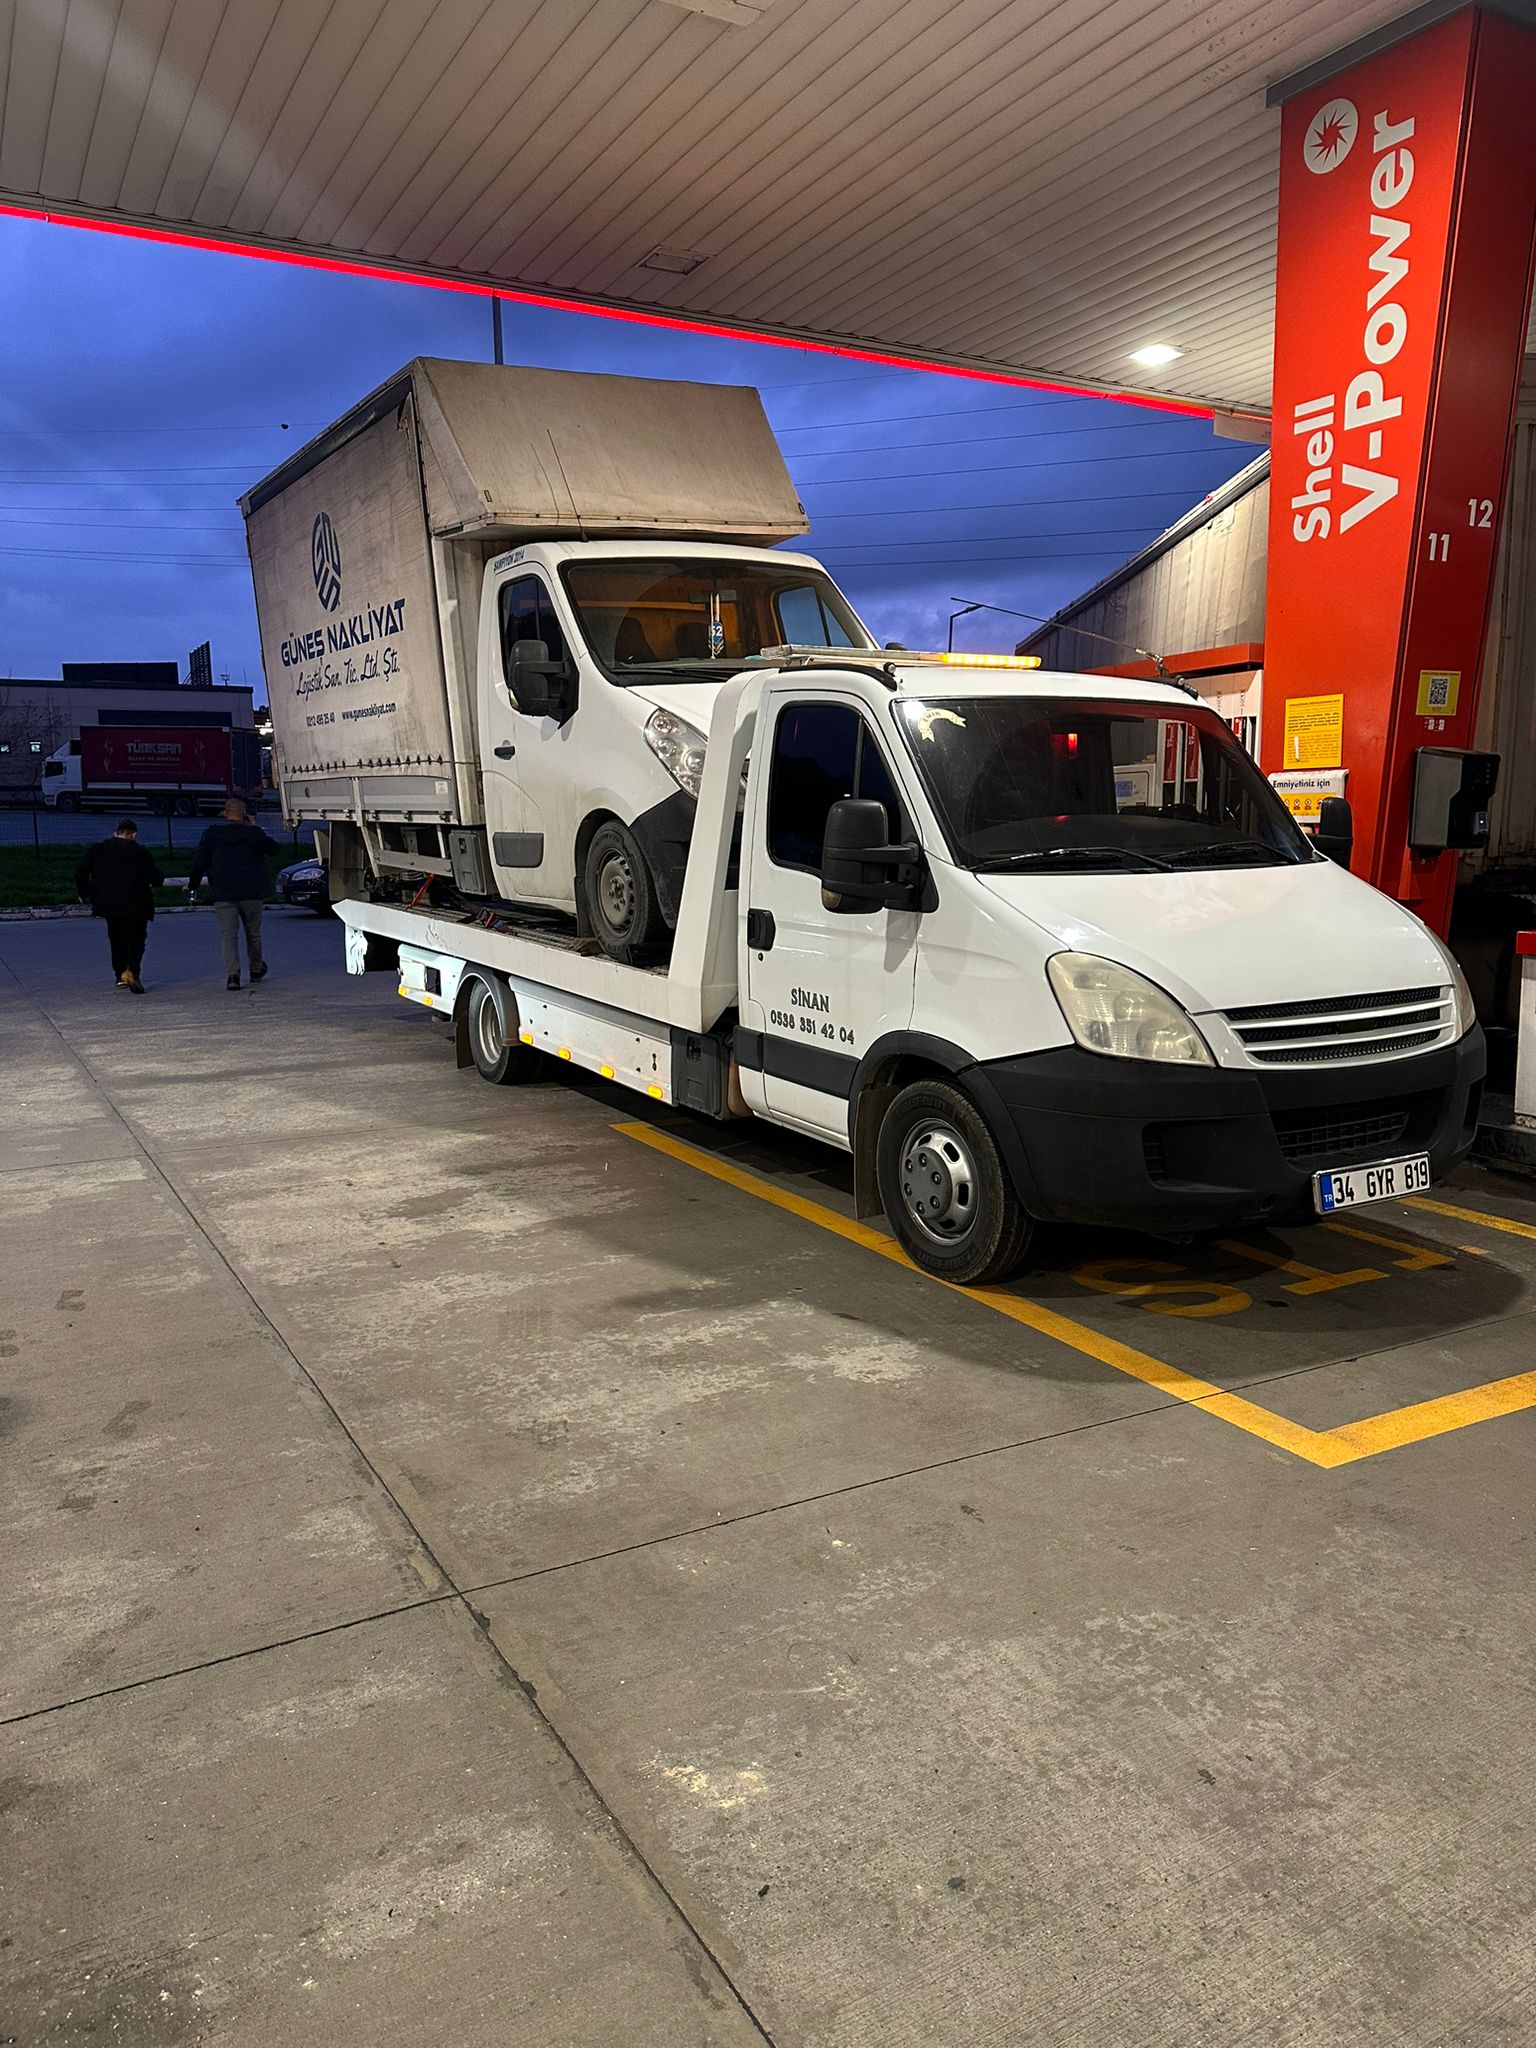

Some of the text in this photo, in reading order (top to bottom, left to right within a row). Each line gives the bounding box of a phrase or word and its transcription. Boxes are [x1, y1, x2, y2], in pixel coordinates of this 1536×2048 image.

[1339, 109, 1416, 535] V-Power
[1291, 393, 1335, 543] Shell
[1468, 498, 1494, 528] 12
[1428, 532, 1450, 562] 11
[327, 598, 405, 653] NAKLİYAT
[360, 650, 380, 681] Ltd.
[1272, 778, 1331, 790] Emniyetiniz için
[791, 987, 829, 1012] SİNAN
[821, 1023, 835, 1040] 42
[840, 1026, 855, 1045] 04
[1333, 1160, 1428, 1204] 34 GYR 819
[1323, 1194, 1334, 1203] TR
